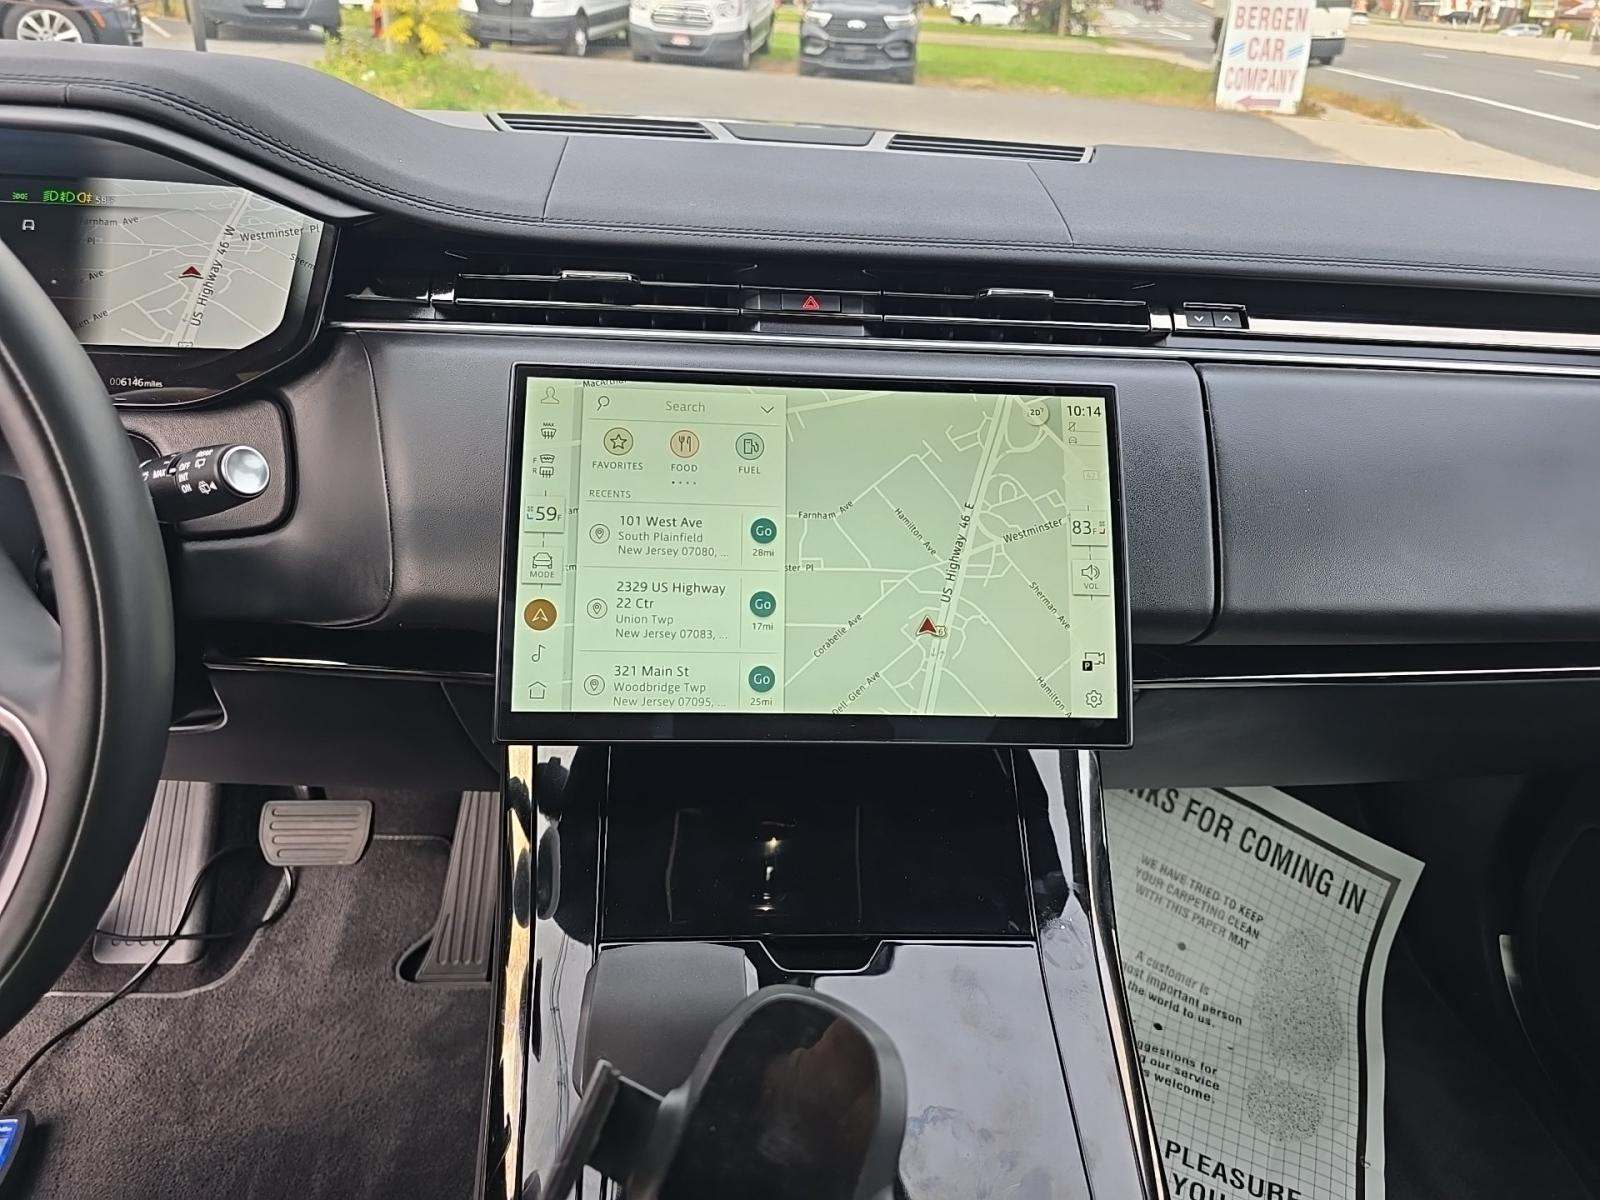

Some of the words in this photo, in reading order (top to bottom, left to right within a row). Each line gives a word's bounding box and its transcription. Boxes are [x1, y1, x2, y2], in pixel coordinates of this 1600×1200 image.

[1236, 6, 1308, 31] BERGEN
[1248, 37, 1285, 61] CAR
[1225, 66, 1296, 92] COMPANY
[122, 216, 139, 225] Ave
[223, 225, 236, 237] W
[240, 227, 304, 242] Westminster
[310, 224, 320, 234] Pl
[217, 241, 230, 256] 46
[197, 259, 223, 306] Highway
[93, 310, 109, 321] Ave
[191, 311, 204, 327] US
[665, 400, 706, 413] Search
[1066, 405, 1102, 418] 10:14
[592, 460, 644, 471] FAVORITES
[670, 463, 698, 473] FOOD
[738, 465, 761, 475] FUEL
[589, 489, 631, 499] RECENTS
[798, 511, 836, 520] Farnham
[839, 500, 854, 515] Ave
[964, 501, 975, 510] E
[619, 515, 641, 527] 101
[646, 516, 677, 528] West
[681, 517, 703, 528] Ave
[959, 513, 971, 530] 46
[617, 531, 650, 542] South
[653, 532, 703, 544] Plainfield
[755, 525, 772, 537] Go
[894, 507, 924, 541] Hamilton
[922, 540, 937, 556] Ave
[1003, 518, 1063, 544] Westminster
[617, 545, 643, 555] New
[645, 546, 679, 558] Jersey
[681, 547, 717, 559] 07080,
[752, 548, 775, 557] 28mi
[946, 535, 968, 583] Highway
[805, 562, 814, 571] Pl
[529, 570, 554, 578] MODE
[616, 581, 648, 592] 2329
[652, 582, 668, 593] US
[672, 583, 726, 596] Highway
[1083, 582, 1099, 590] VOL
[940, 586, 953, 603] US
[616, 597, 631, 609] 22
[635, 598, 655, 609] Ctr
[754, 598, 772, 610] Go
[1029, 581, 1058, 614] Sherman
[1057, 614, 1071, 630] Ave
[616, 614, 647, 625] Union
[652, 615, 674, 627] Twp
[752, 621, 774, 631] 17mi
[615, 628, 642, 639] New
[644, 629, 677, 641] Jersey
[680, 629, 716, 641] 07083,
[813, 626, 847, 658] Corabelle
[846, 613, 863, 629] Ave
[614, 665, 637, 677] 321
[641, 666, 674, 677] Main
[677, 666, 690, 677] St
[753, 673, 771, 685] Go
[847, 685, 866, 702] Glen
[865, 670, 881, 687] Ave
[613, 681, 680, 694] Woodbridge
[682, 682, 706, 694] Twp
[1036, 676, 1066, 711] Hamilton
[613, 697, 639, 707] New
[642, 698, 675, 709] Jersey
[750, 696, 773, 706] 25mi
[1182, 797, 1234, 843] FOR
[1239, 826, 1335, 898] COMING
[1338, 879, 1368, 915] IN
[1141, 854, 1158, 871] WE
[1159, 863, 1189, 886] HAVE
[1188, 878, 1221, 902] TRIED
[1223, 896, 1237, 910] TO
[1237, 904, 1264, 924] KEEP
[1136, 866, 1164, 889] YOUR
[1165, 882, 1226, 921] CARPETING
[1227, 914, 1260, 940] CLEAN
[1135, 883, 1162, 905] WITH
[1165, 899, 1190, 919] THIS
[1191, 911, 1227, 938] PAPER
[1227, 931, 1250, 951] MAT
[1134, 950, 1144, 963] A
[1145, 957, 1199, 990] customer
[1199, 981, 1211, 996] is
[1127, 980, 1146, 997] the
[1148, 989, 1180, 1014] world
[1182, 1006, 1195, 1020] to
[1146, 972, 1200, 1009] important
[1201, 1001, 1243, 1026] person
[1149, 1057, 1171, 1072] our
[1173, 1065, 1220, 1092] service
[1200, 1061, 1218, 1076] for
